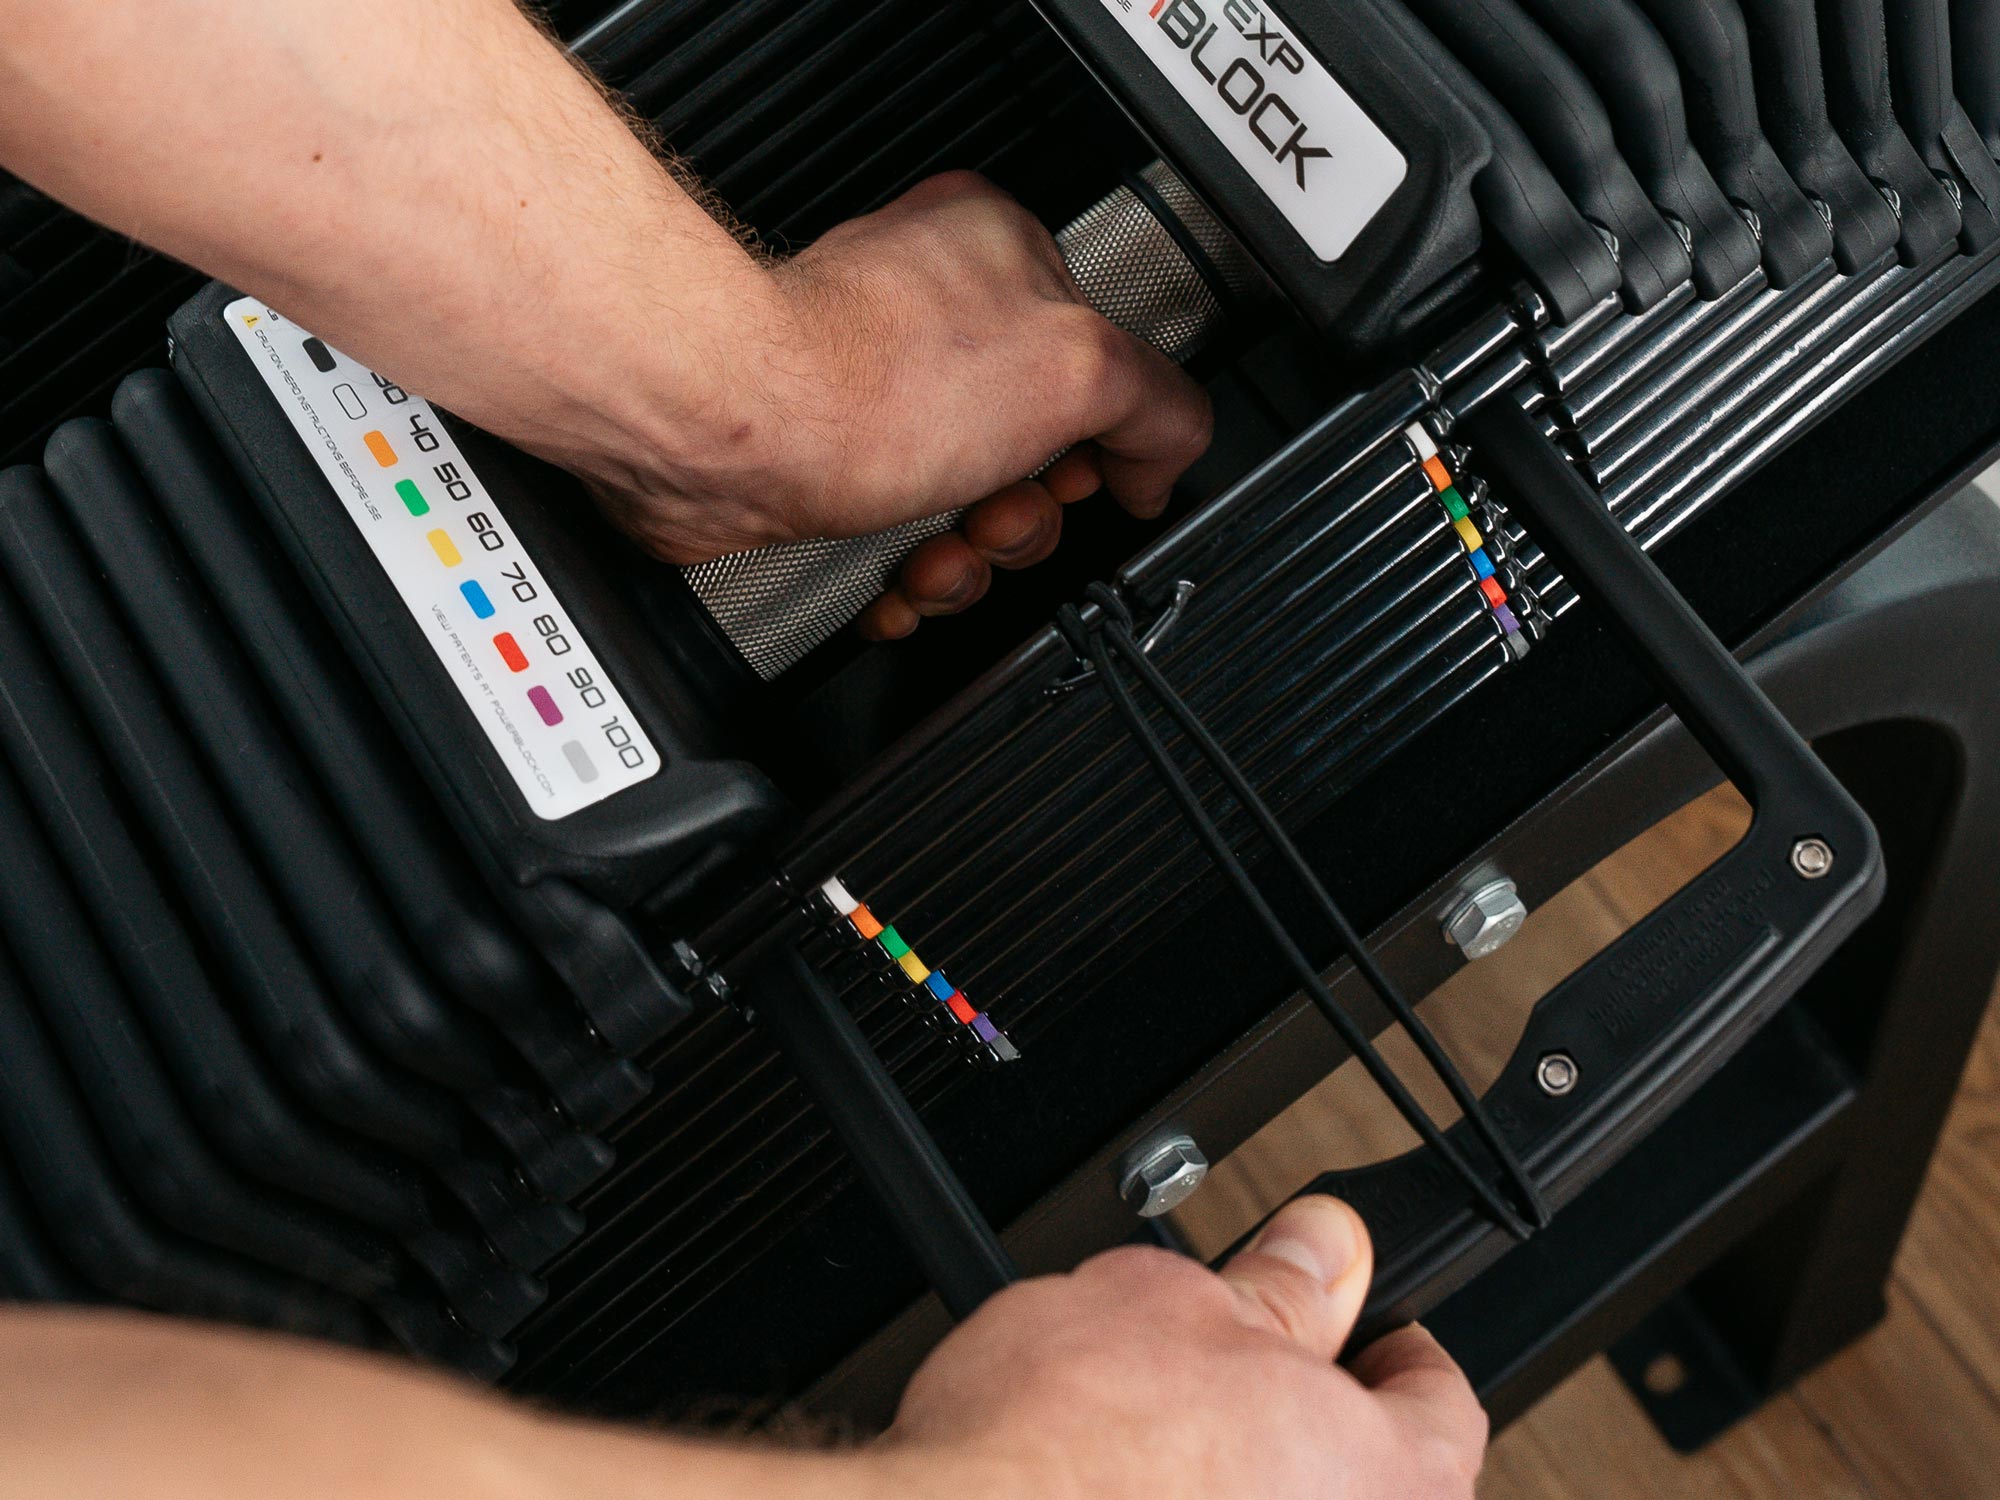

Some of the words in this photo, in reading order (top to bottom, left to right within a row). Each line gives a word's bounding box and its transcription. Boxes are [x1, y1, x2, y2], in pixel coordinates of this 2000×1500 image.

[1223, 0, 1304, 75] EXP
[1149, 0, 1333, 192] BLOCK
[283, 369, 302, 396] READ
[297, 396, 344, 462] INSTRUCTIONS
[339, 461, 369, 500] BEFORE
[364, 500, 383, 521] USE
[409, 414, 440, 452] 40
[433, 461, 472, 501] 50
[466, 512, 504, 551] 60
[501, 561, 538, 602] 70
[533, 614, 572, 656] 80
[431, 604, 451, 632] VIEW
[449, 632, 483, 682] PATENTS
[480, 682, 495, 697] AT
[491, 699, 556, 797] POWERBLOCK.COM
[566, 667, 606, 709] 90
[601, 716, 645, 769] 100
